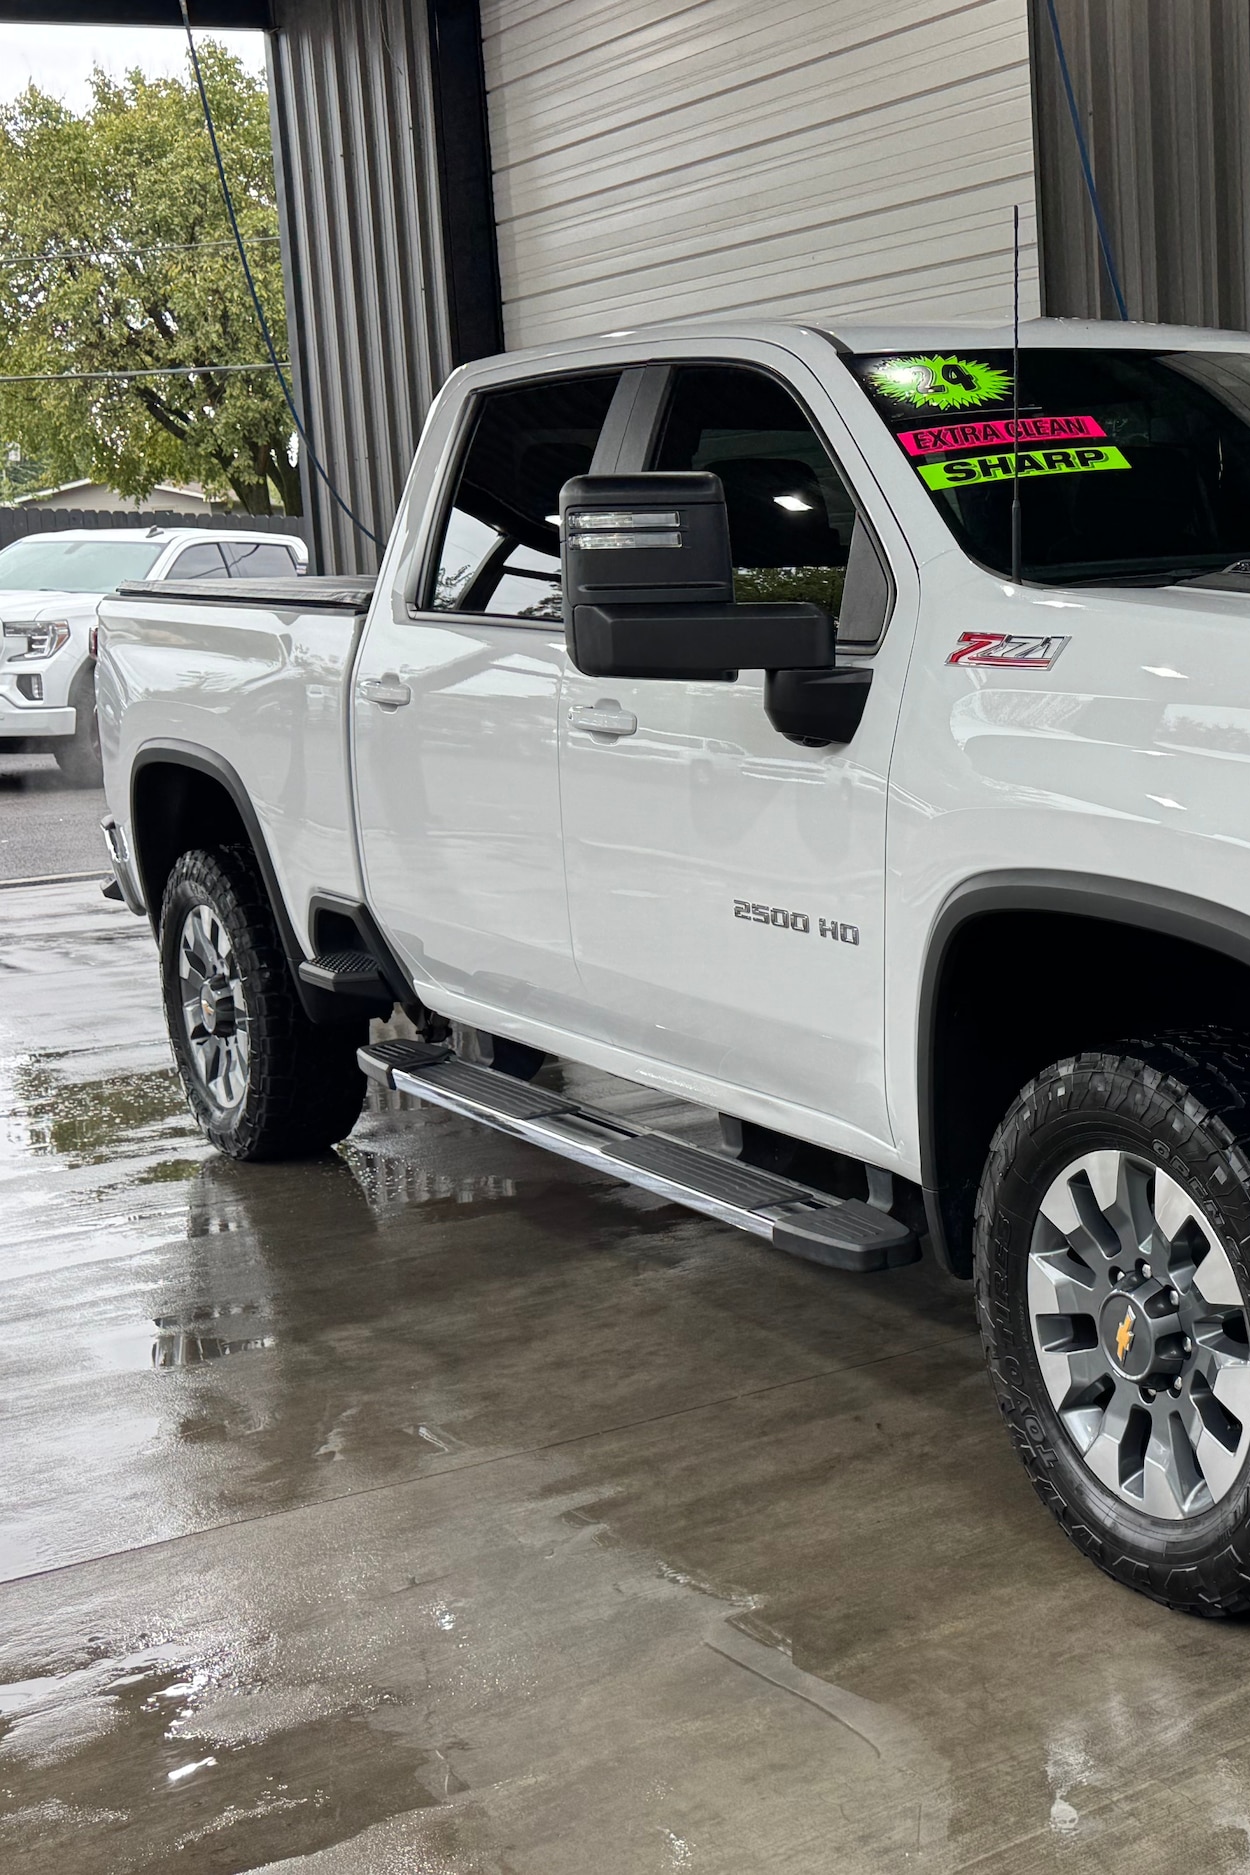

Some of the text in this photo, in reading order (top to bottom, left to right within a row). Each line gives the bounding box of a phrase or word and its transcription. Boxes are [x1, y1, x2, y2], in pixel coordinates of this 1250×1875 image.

[909, 364, 978, 395] 24
[911, 417, 1087, 450] EXTRA CLEAN
[942, 449, 1110, 483] SHARP
[944, 631, 1073, 671] Z71
[733, 899, 860, 946] 2500 HD
[1004, 1353, 1059, 1469] TOYO
